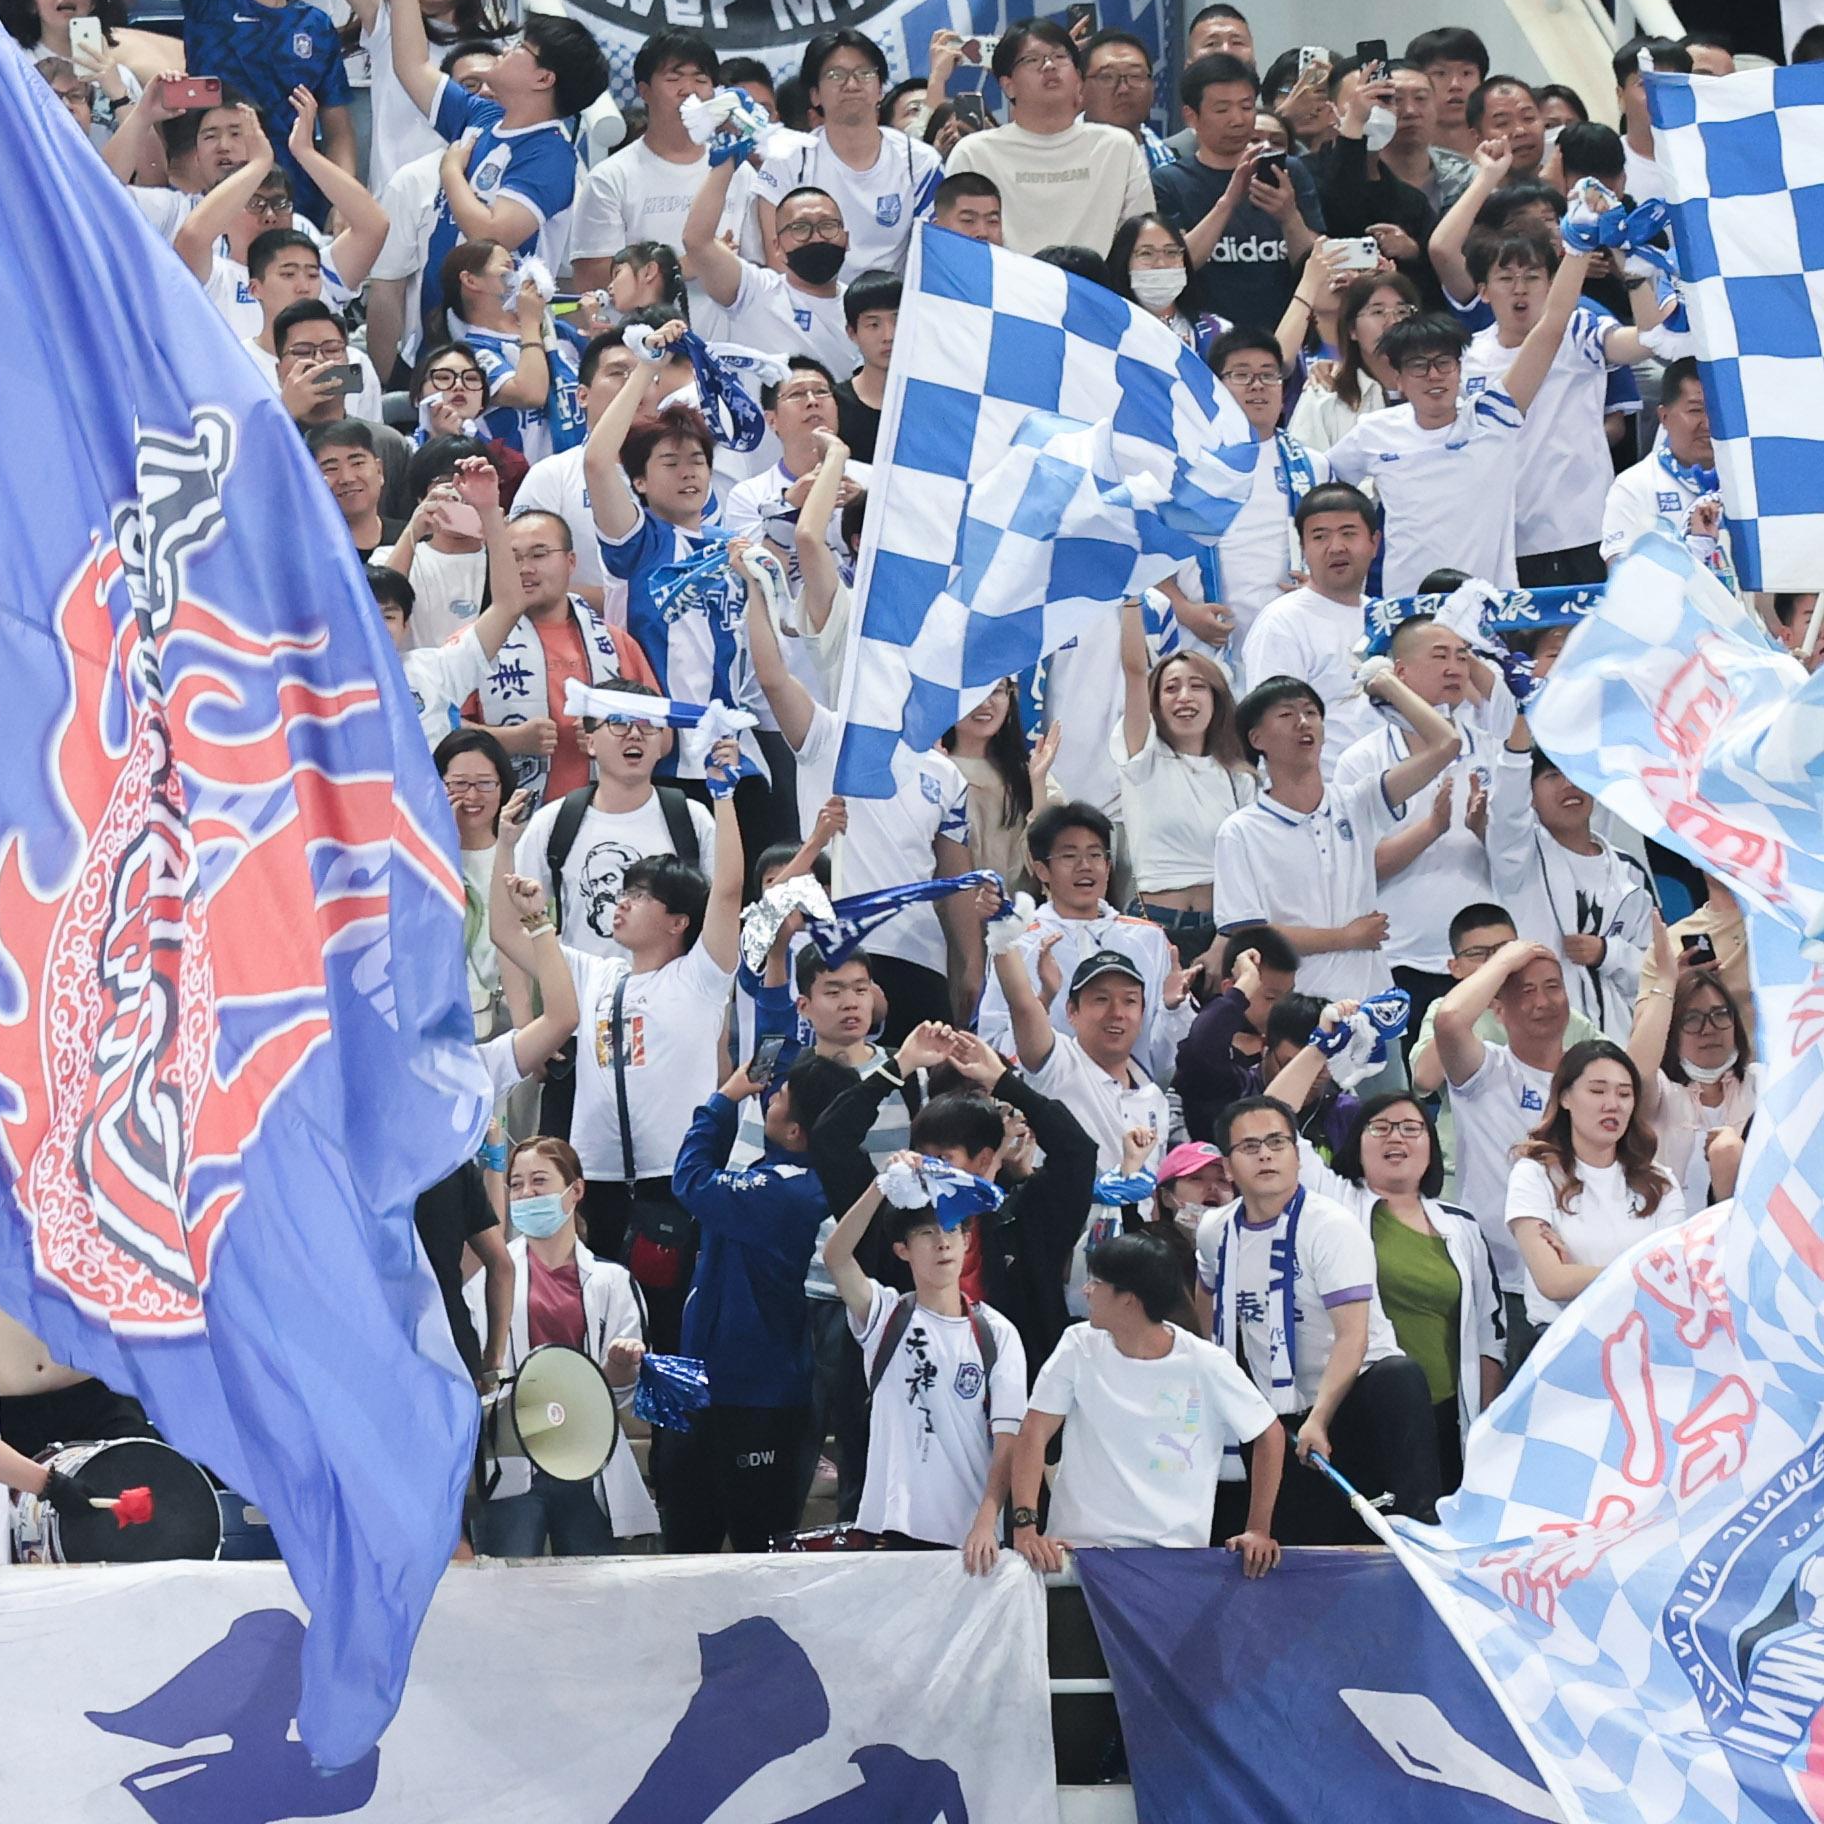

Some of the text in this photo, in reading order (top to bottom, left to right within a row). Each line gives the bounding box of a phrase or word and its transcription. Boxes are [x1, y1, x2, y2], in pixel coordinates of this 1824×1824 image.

[1206, 236, 1289, 264] didas
[1370, 589, 1540, 635] 乘风浪
